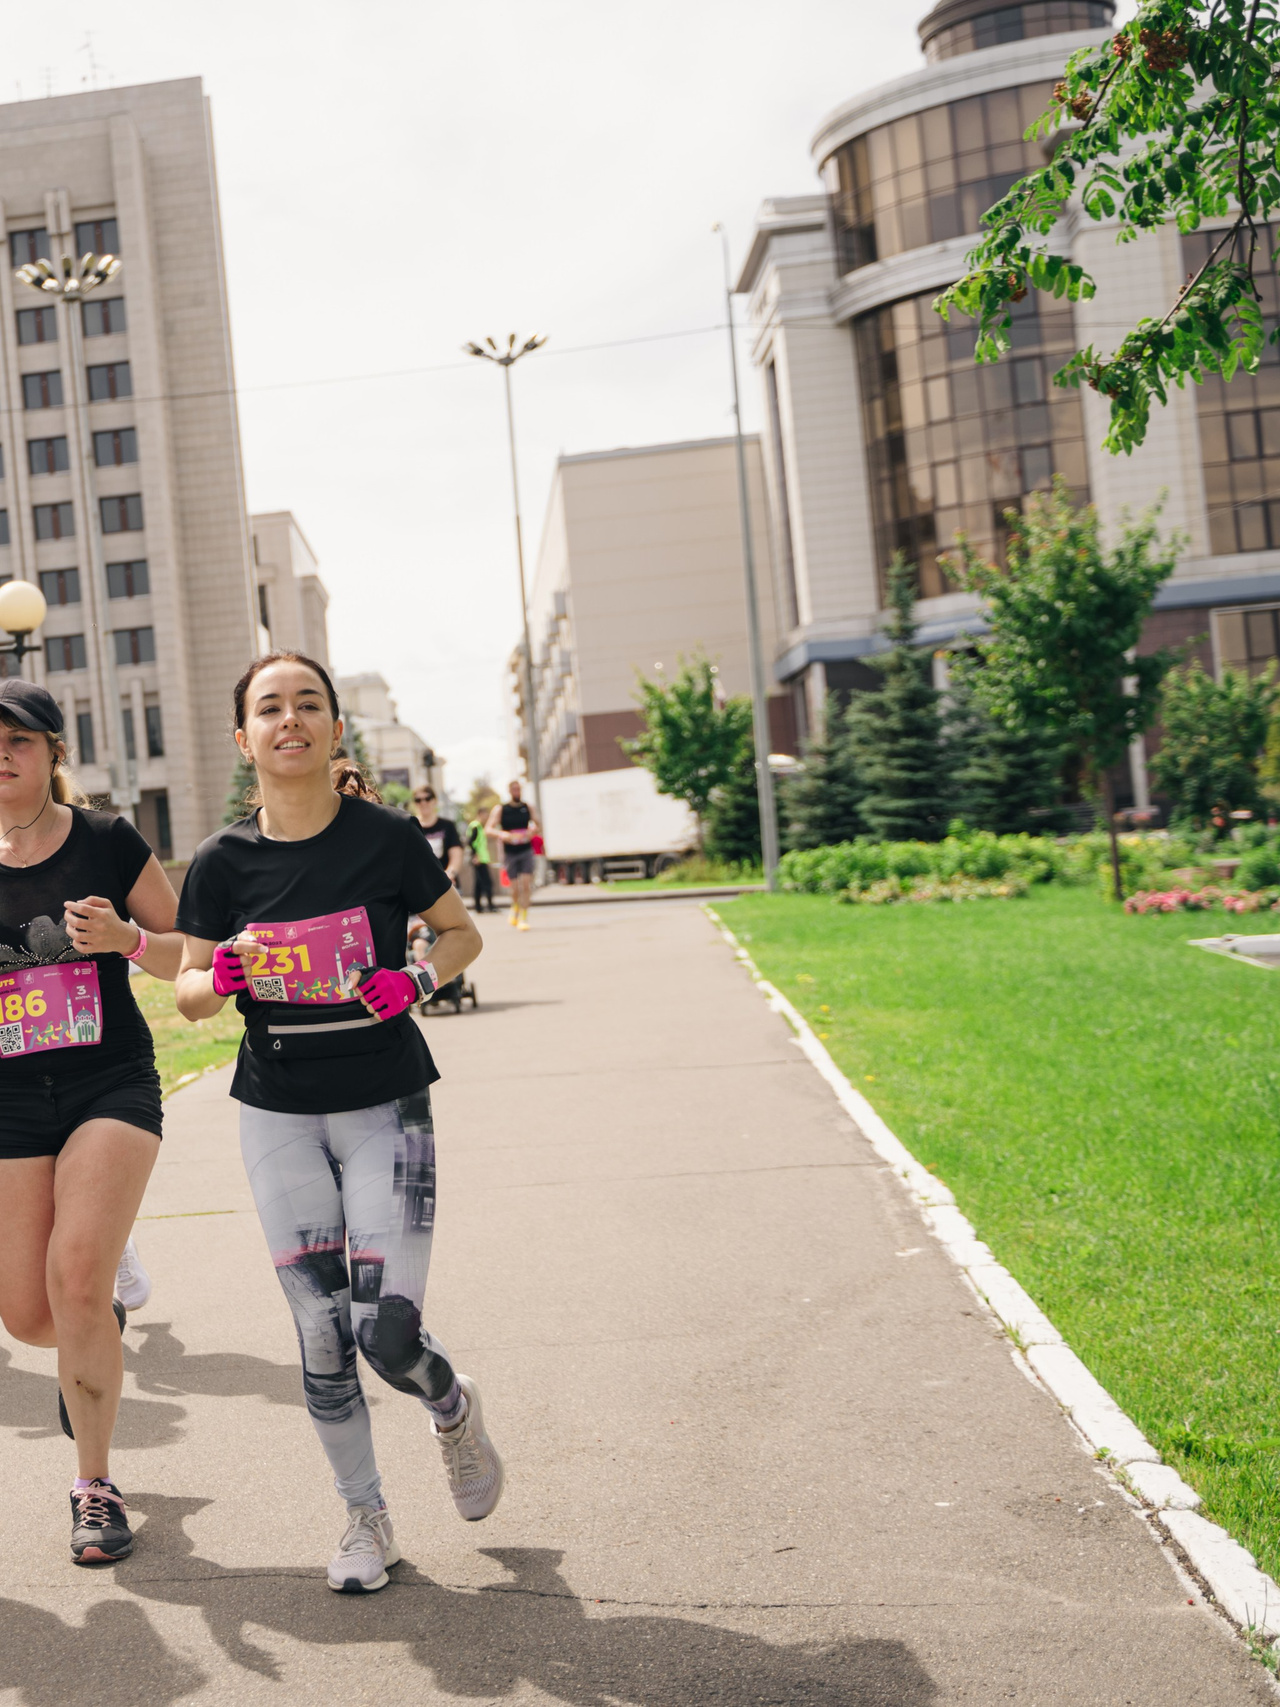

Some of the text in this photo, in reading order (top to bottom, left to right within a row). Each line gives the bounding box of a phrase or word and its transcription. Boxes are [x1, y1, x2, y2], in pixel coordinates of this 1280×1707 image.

[342, 931, 354, 944] 3
[251, 944, 312, 975] 231
[76, 985, 87, 996] 3
